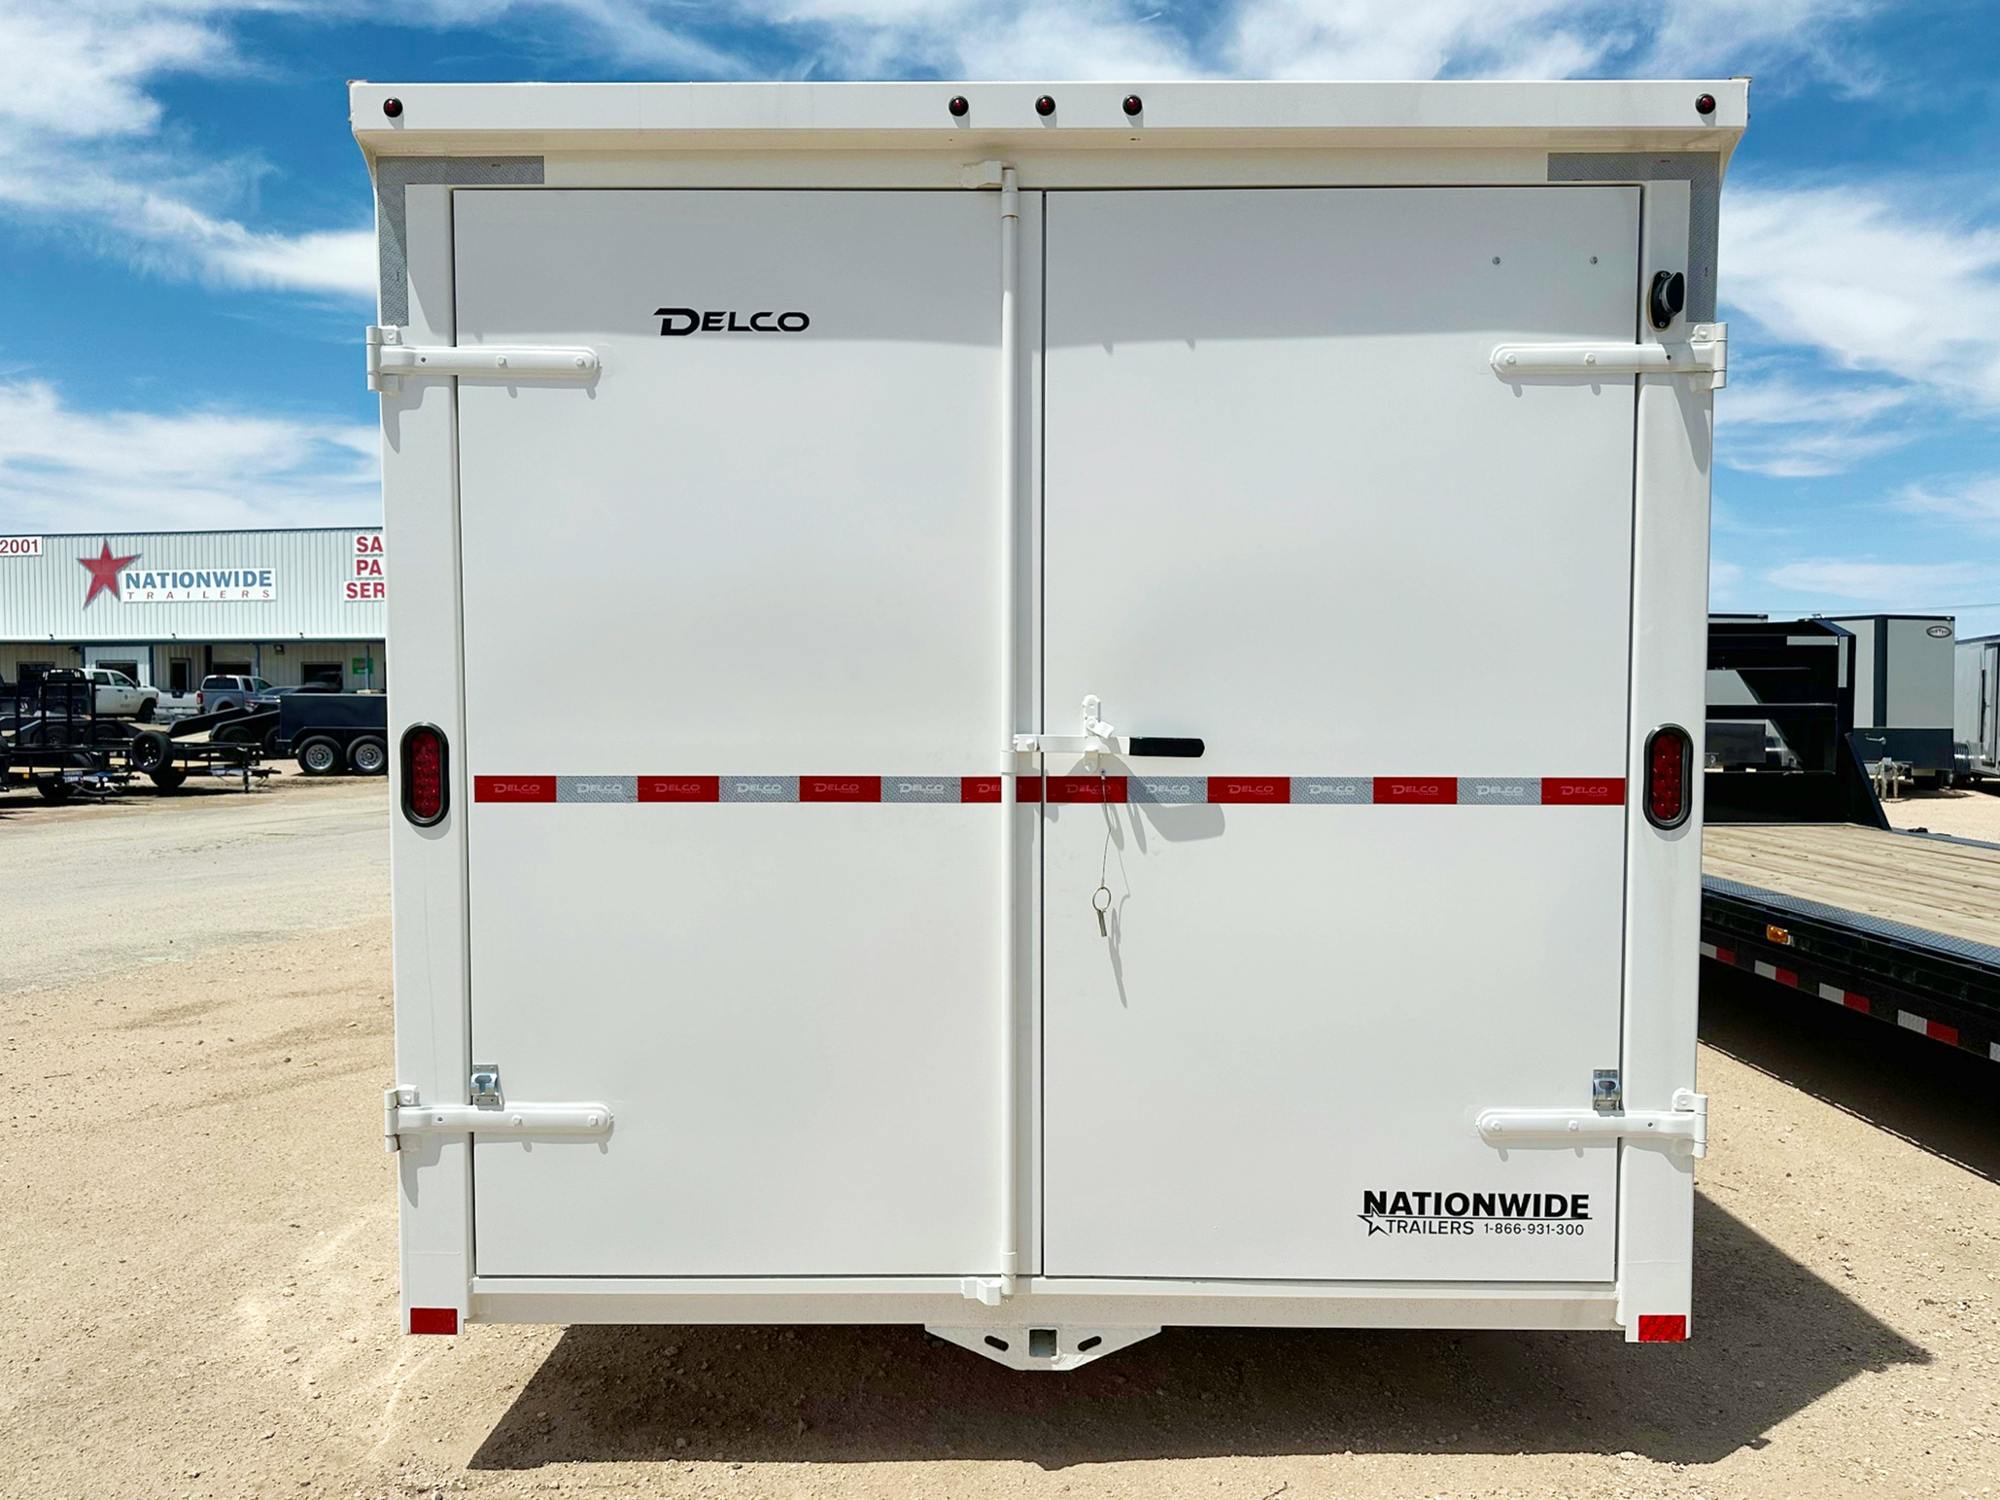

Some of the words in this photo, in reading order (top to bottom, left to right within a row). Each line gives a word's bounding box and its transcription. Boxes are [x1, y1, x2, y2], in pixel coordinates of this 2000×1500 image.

[653, 308, 810, 336] DELCO
[0, 539, 38, 553] 2001
[125, 570, 273, 589] NATIONWIDE
[127, 589, 270, 600] TRAILERS
[493, 783, 540, 793] DELCO
[576, 784, 623, 794] DELCO
[654, 783, 701, 793] DELCO
[736, 783, 782, 793] DELCO
[813, 783, 860, 793] DELCO
[899, 783, 945, 793] DELCO
[1146, 784, 1190, 794] DELCO
[1227, 784, 1274, 794] DELCO
[1309, 784, 1355, 795] DELCO
[1391, 785, 1439, 795] DELCO
[1476, 785, 1524, 796] DELCO
[1560, 785, 1608, 796] DELCO
[1363, 1190, 1590, 1219] NATIONWIDE
[1386, 1219, 1475, 1235] TRAILERS
[1484, 1223, 1585, 1236] 1-866-931-300
